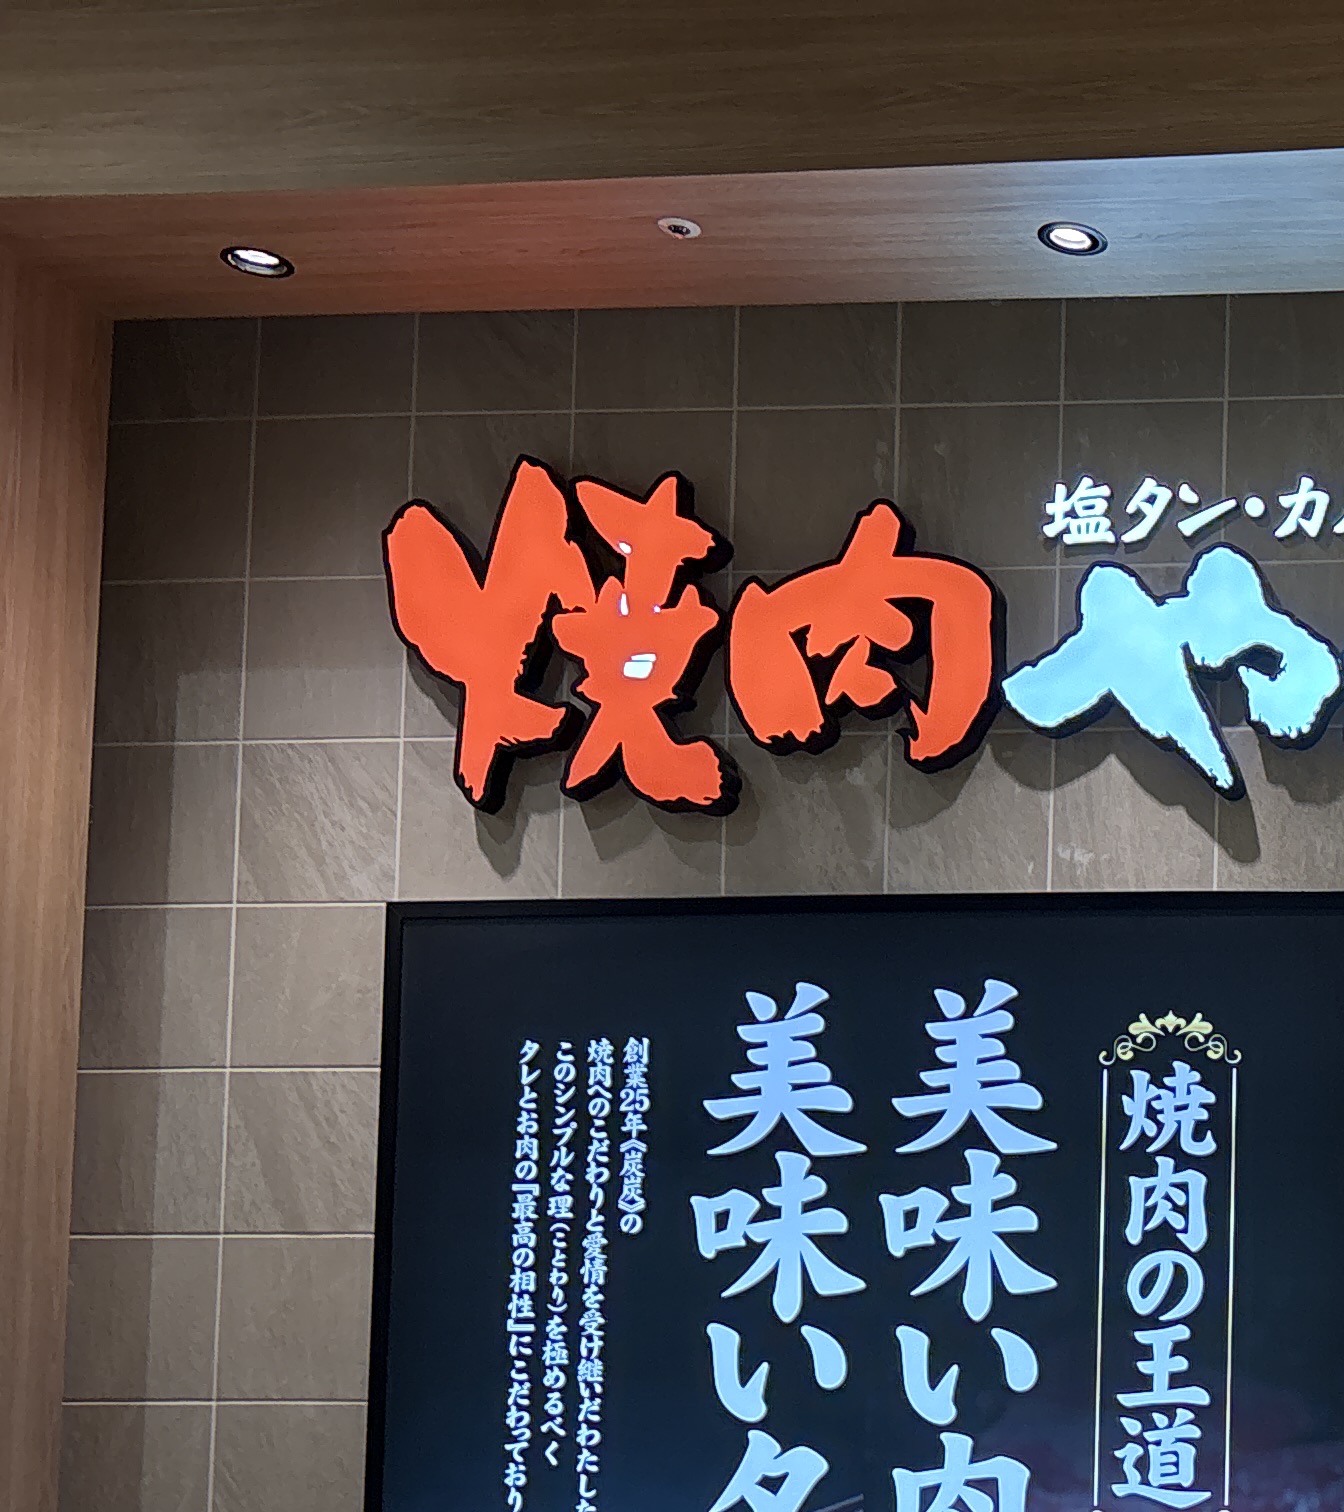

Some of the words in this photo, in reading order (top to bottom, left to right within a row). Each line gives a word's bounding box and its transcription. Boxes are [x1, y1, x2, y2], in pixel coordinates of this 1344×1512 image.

[1111, 1059, 1217, 1511] 焼肉の王道
